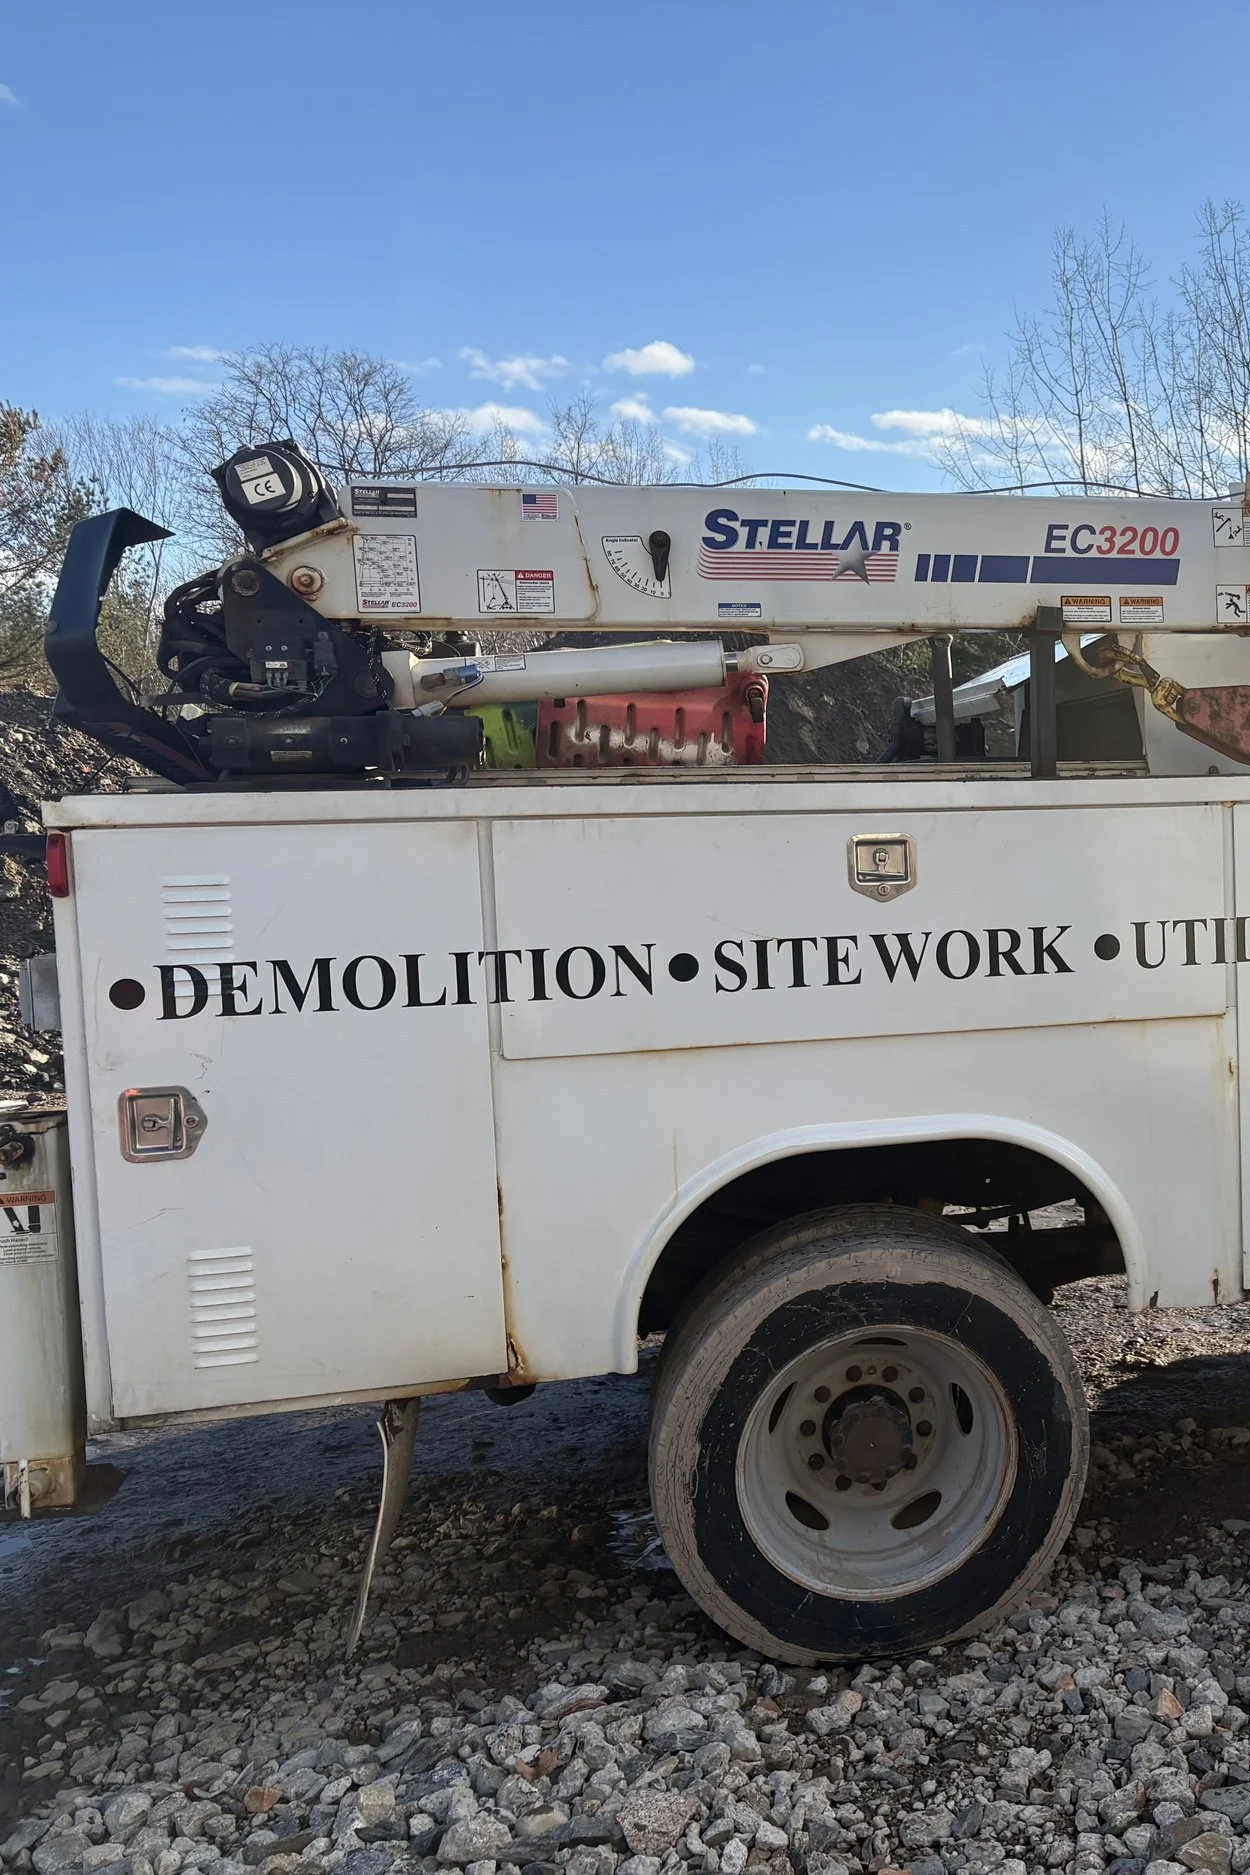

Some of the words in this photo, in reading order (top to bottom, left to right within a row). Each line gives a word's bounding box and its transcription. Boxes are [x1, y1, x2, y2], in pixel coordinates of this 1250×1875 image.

[254, 480, 276, 496] CE
[701, 508, 902, 552] STELLAR
[1044, 523, 1180, 557] EC3200
[153, 943, 657, 1021] DEMOLITION
[6, 1194, 47, 1204] WARNING
